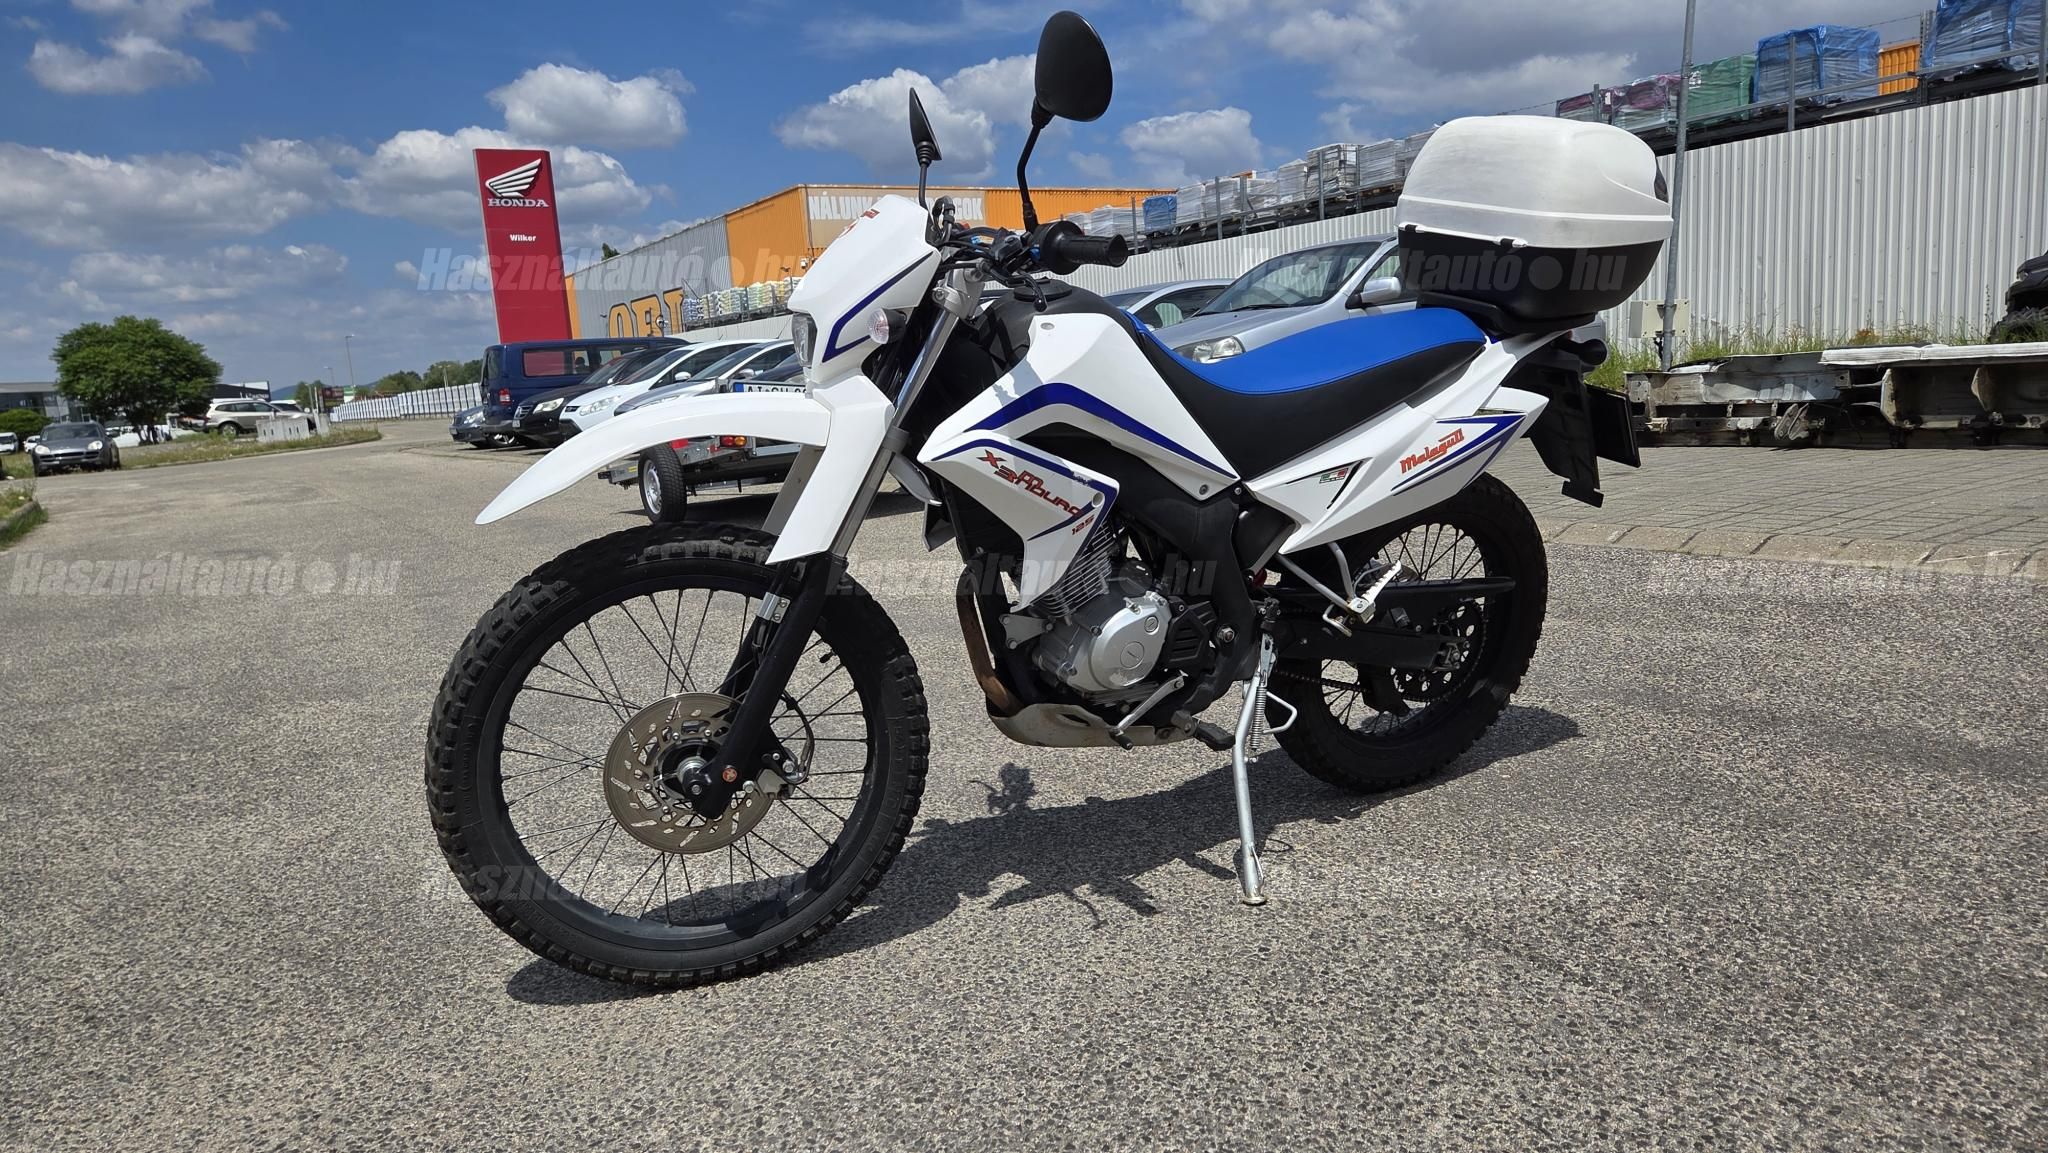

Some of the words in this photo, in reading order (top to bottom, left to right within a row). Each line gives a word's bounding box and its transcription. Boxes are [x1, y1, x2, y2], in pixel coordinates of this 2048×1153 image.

[487, 198, 549, 207] HONDA
[509, 234, 537, 242] Wilker
[609, 287, 684, 337] OBI
[1400, 428, 1464, 474] Malaguti
